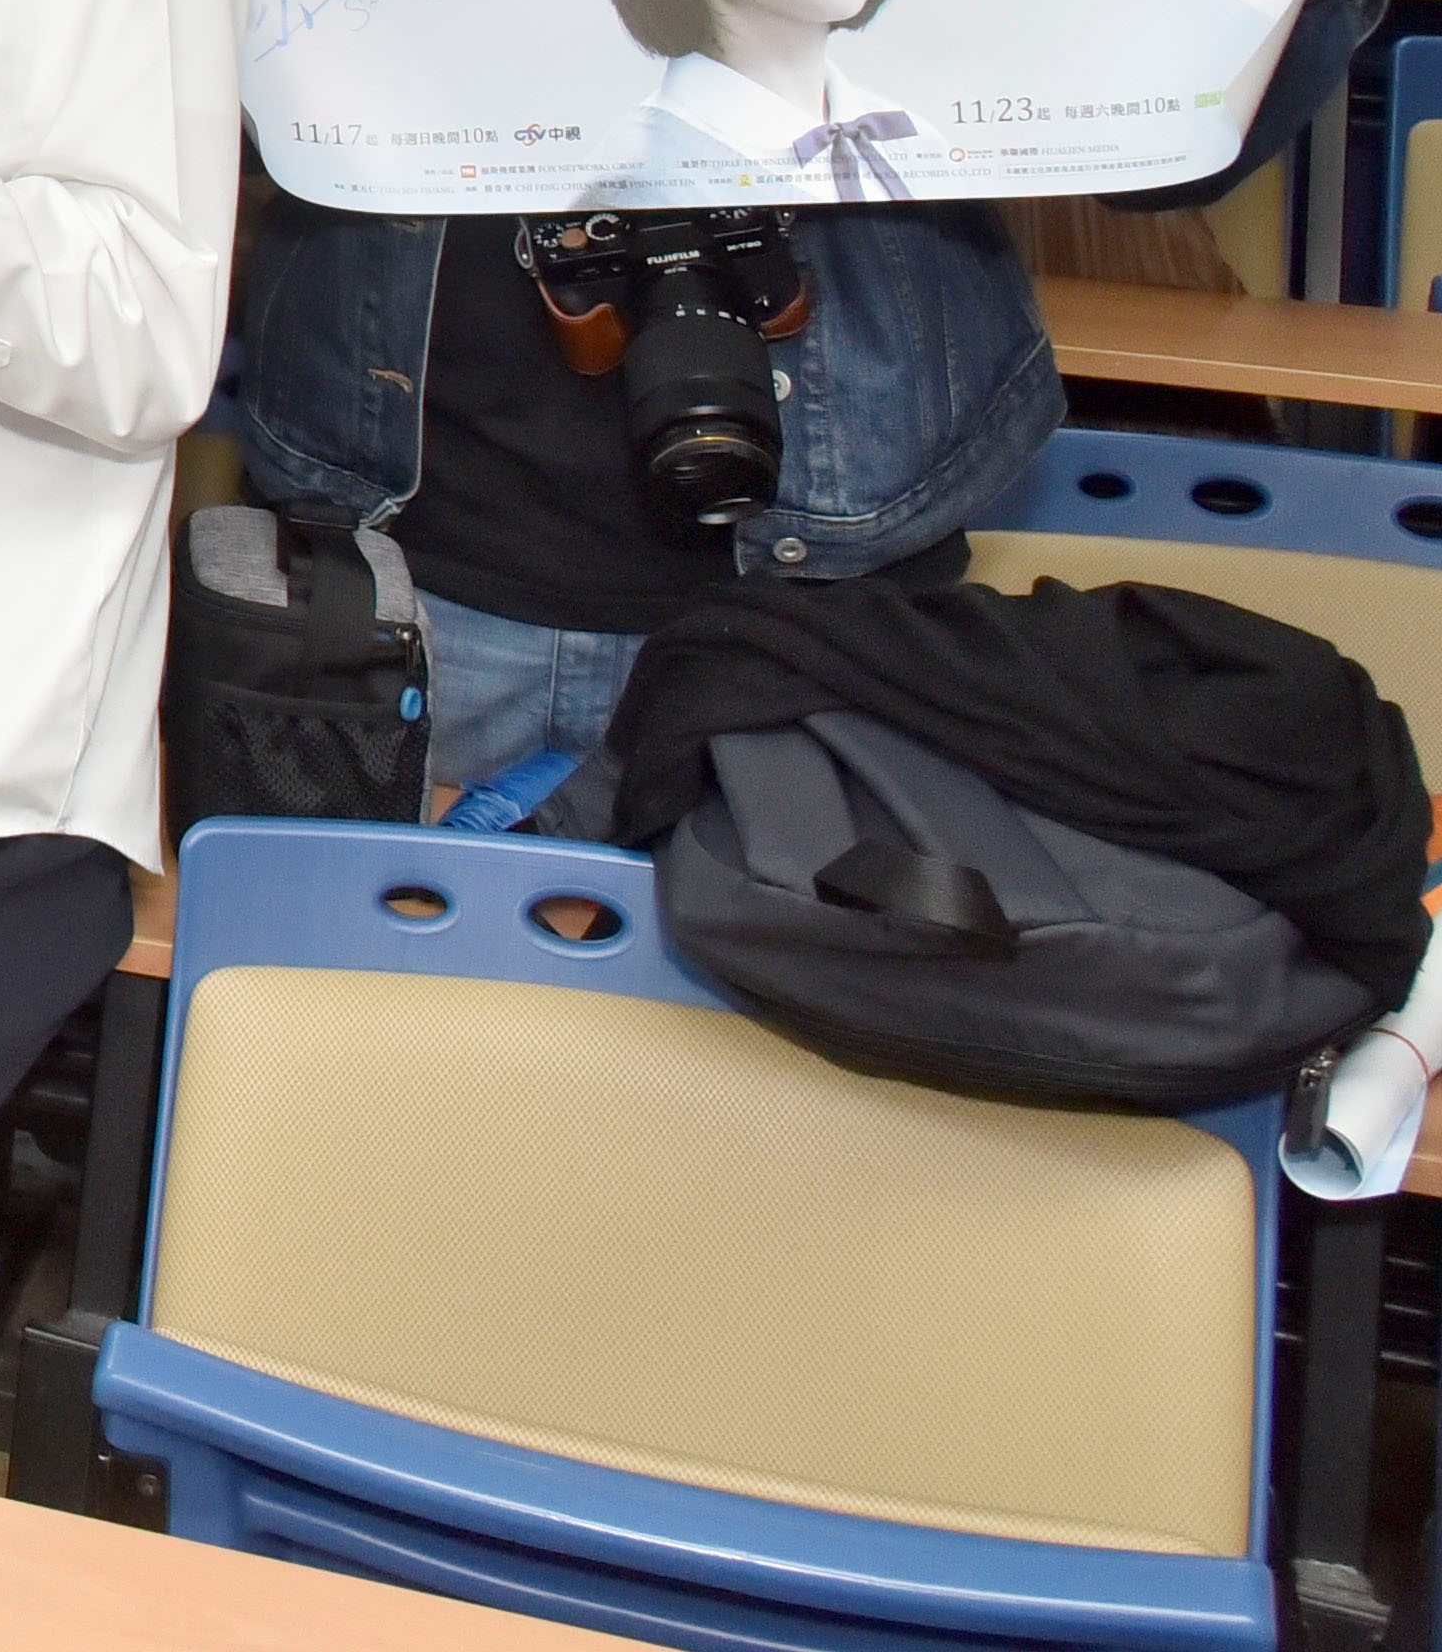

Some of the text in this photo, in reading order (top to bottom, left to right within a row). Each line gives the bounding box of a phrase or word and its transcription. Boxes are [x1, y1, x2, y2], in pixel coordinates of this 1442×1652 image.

[950, 96, 1052, 125] 11/23起
[1064, 96, 1181, 120] 每週六晚間10點
[291, 121, 379, 147] 11/17起
[390, 126, 499, 146] 每週日晚間10點
[646, 250, 700, 266] FUJIFILM
